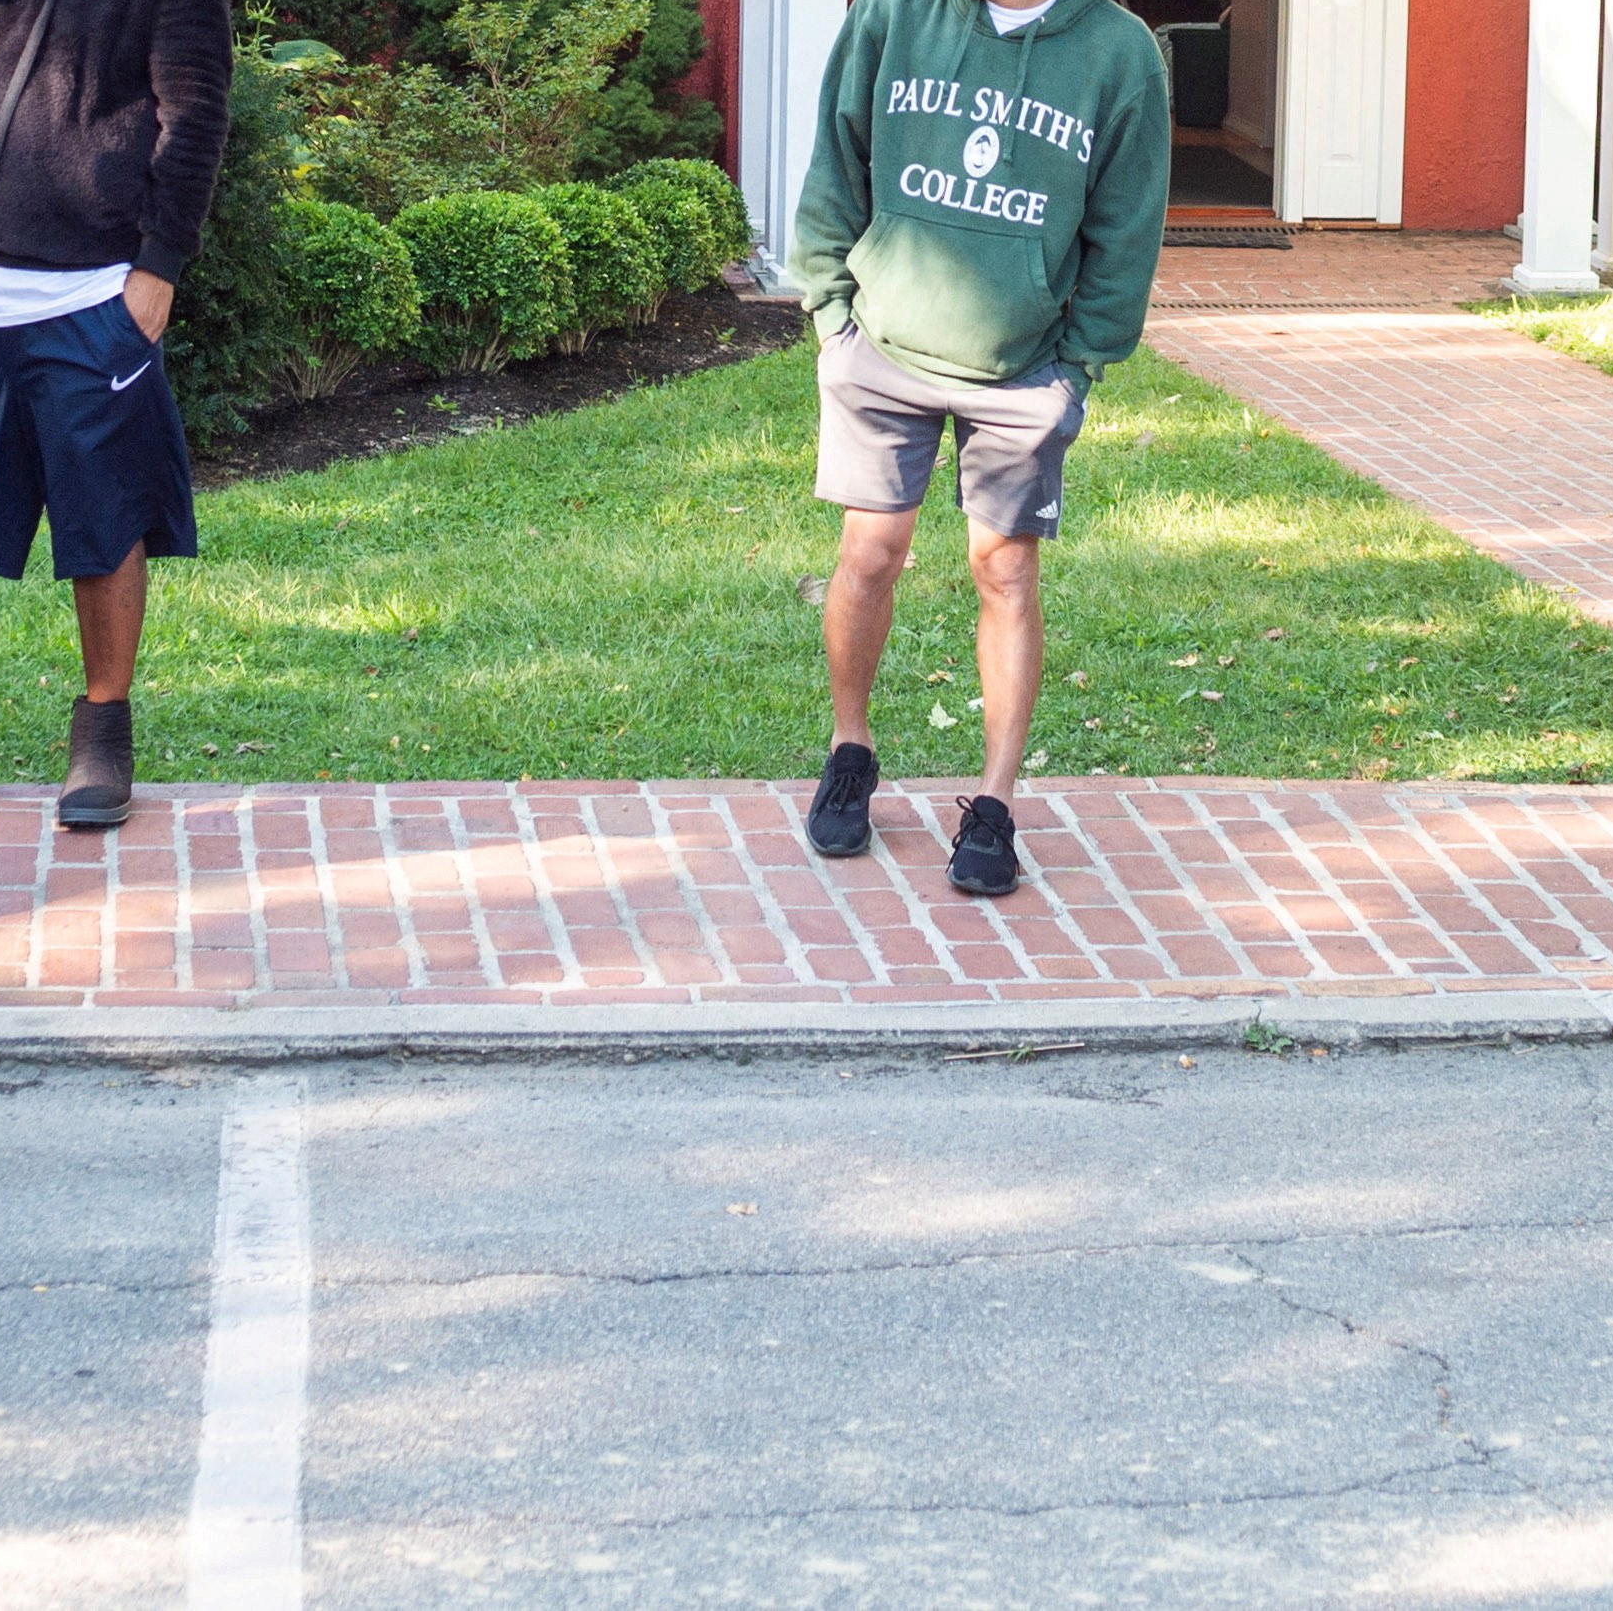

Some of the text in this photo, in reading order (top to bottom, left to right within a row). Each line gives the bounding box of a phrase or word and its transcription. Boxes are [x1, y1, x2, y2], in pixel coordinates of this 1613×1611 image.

[886, 78, 1095, 164] PAUL SMITH'S
[899, 163, 1049, 226] COLLEGE
